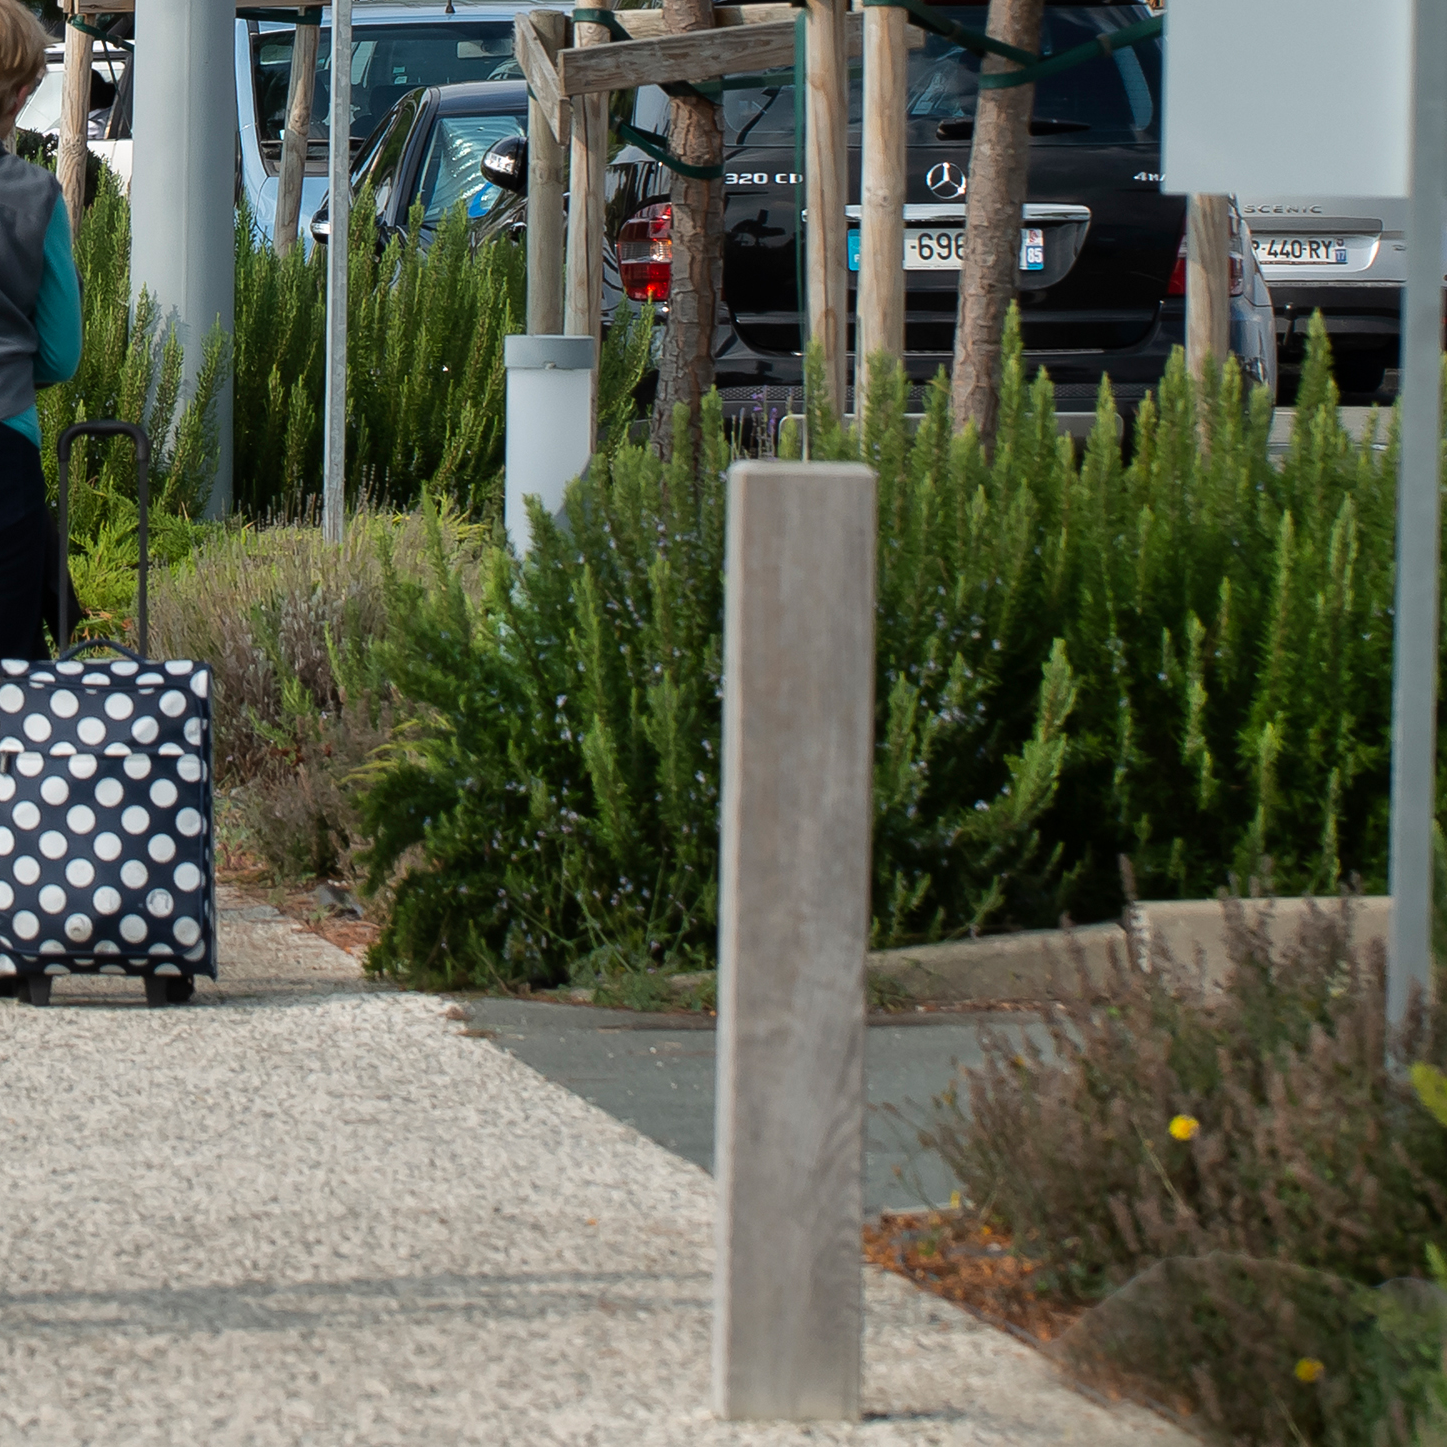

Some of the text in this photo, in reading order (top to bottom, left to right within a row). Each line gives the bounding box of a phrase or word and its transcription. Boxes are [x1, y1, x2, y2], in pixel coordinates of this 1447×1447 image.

[724, 172, 804, 185] 320 CD
[1243, 203, 1323, 214] SCENIC
[1026, 247, 1043, 264] 85
